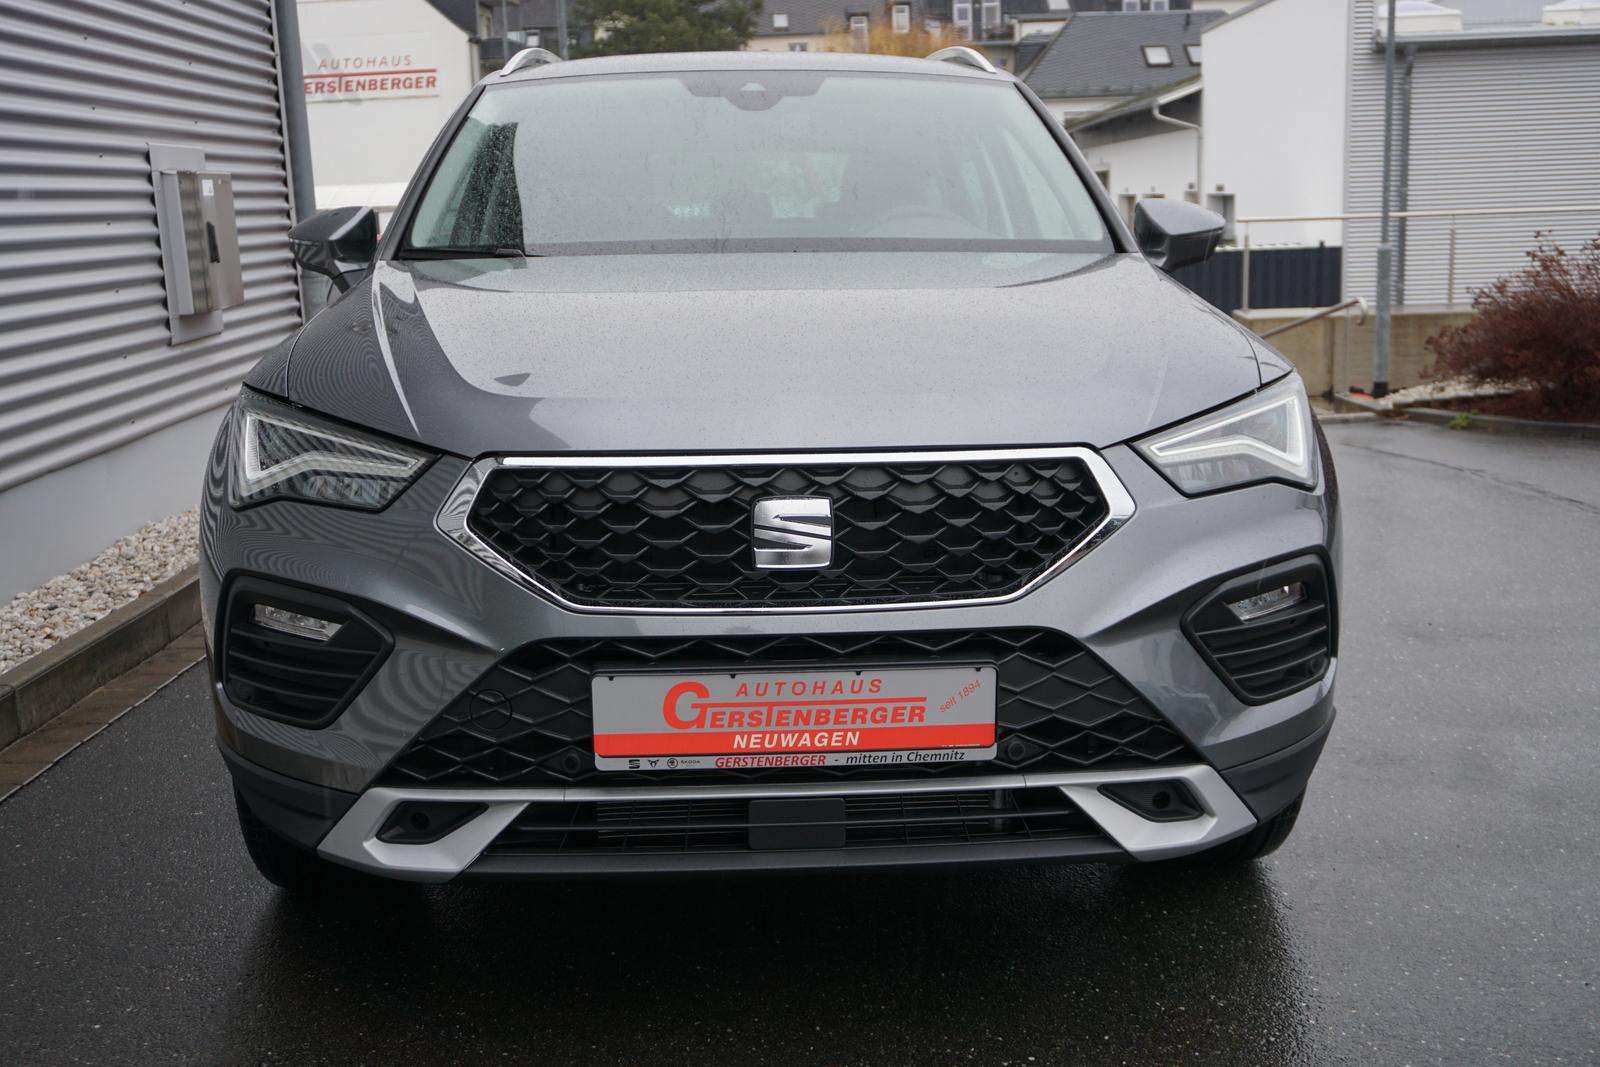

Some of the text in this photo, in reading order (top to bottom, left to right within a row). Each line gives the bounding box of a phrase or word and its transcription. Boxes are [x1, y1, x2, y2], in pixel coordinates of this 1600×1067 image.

[318, 54, 413, 70] AUTOHAUS
[304, 76, 437, 94] ERSTENBERGER
[735, 679, 882, 697] AUTOHAUS
[939, 679, 982, 713] seit 1894
[663, 681, 927, 729] GERSTENBERGER
[733, 731, 860, 749] NEUWAGEN
[715, 755, 826, 768] GERSTENBERGER
[845, 753, 887, 764] mitten
[891, 752, 903, 763] in
[906, 749, 966, 762] Chemnitz
